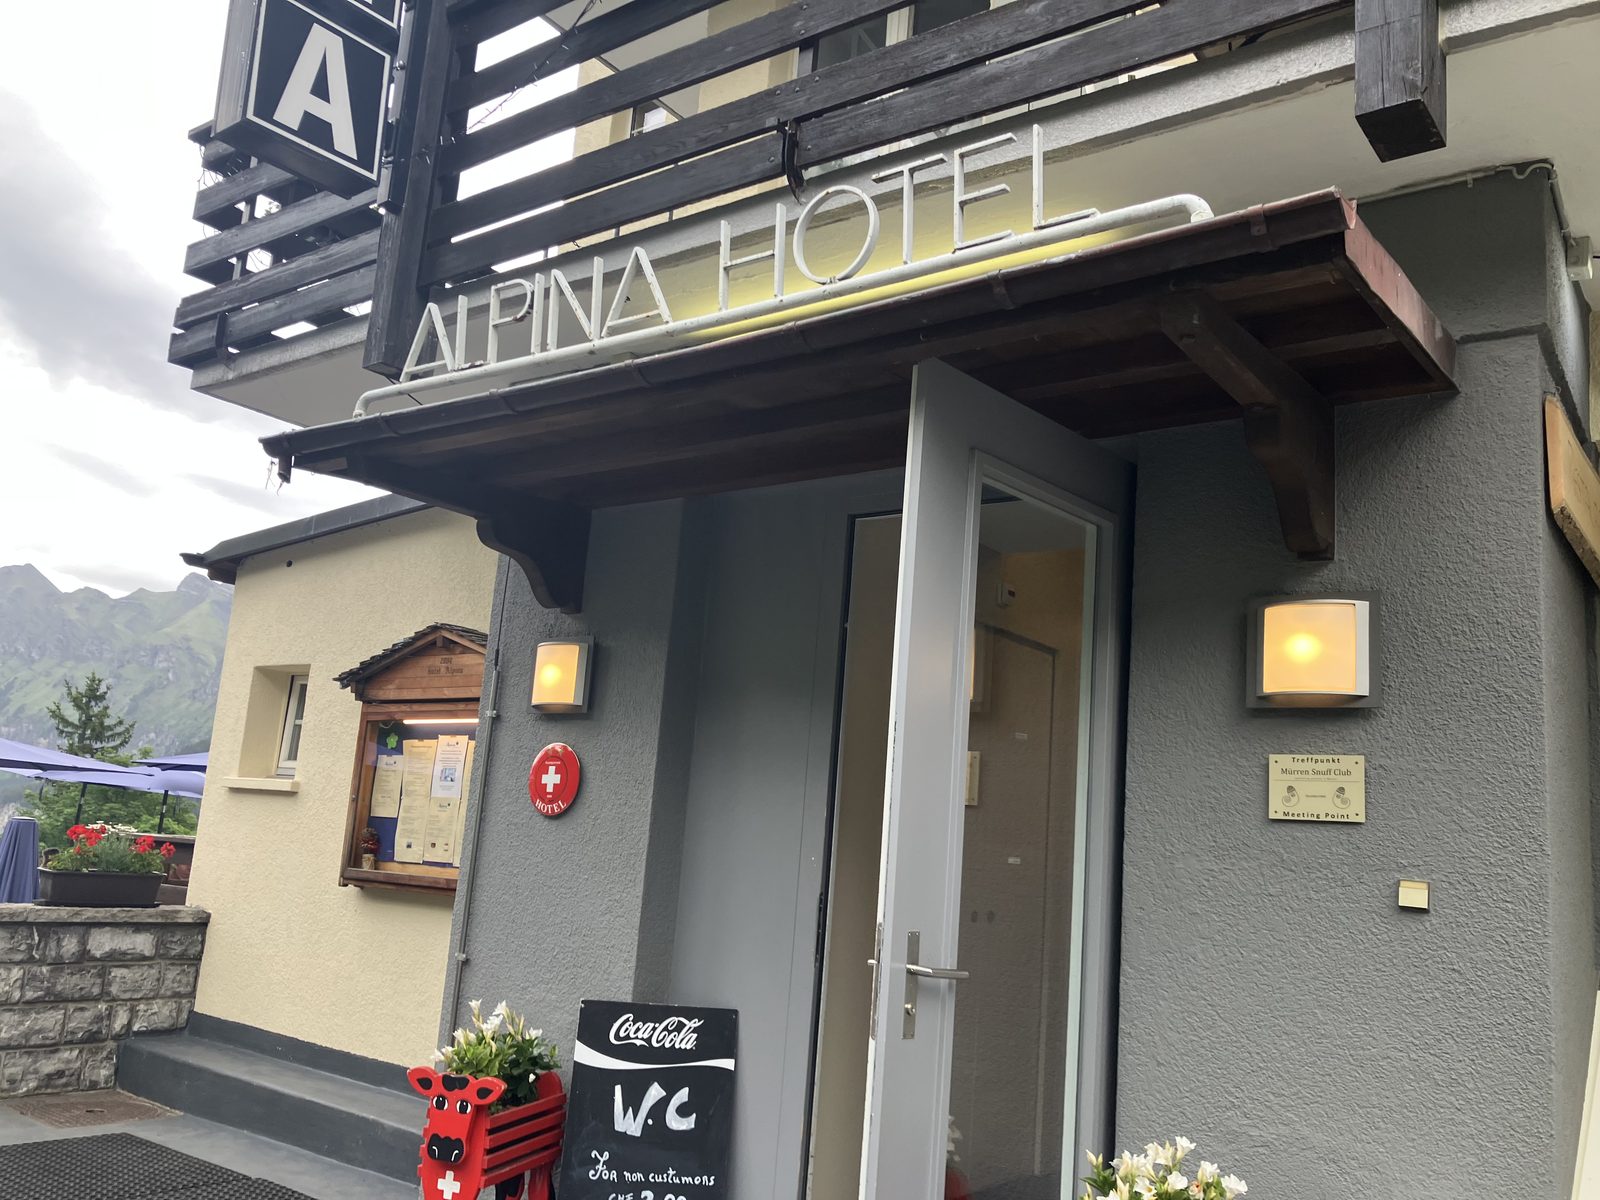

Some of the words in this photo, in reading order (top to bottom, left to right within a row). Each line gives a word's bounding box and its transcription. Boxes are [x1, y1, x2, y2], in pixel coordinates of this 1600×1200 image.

[273, 22, 358, 161] A
[401, 246, 674, 381] ALPINA
[718, 123, 1101, 311] HOTEL
[1280, 768, 1310, 776] Mürren
[1311, 768, 1332, 776] Snuff
[535, 799, 567, 814] HOTEL
[1282, 811, 1321, 820] Meeting
[1325, 812, 1350, 820] Point
[608, 1013, 704, 1051] Coca-Cola
[613, 1081, 697, 1137] W.C
[623, 1171, 645, 1184] non
